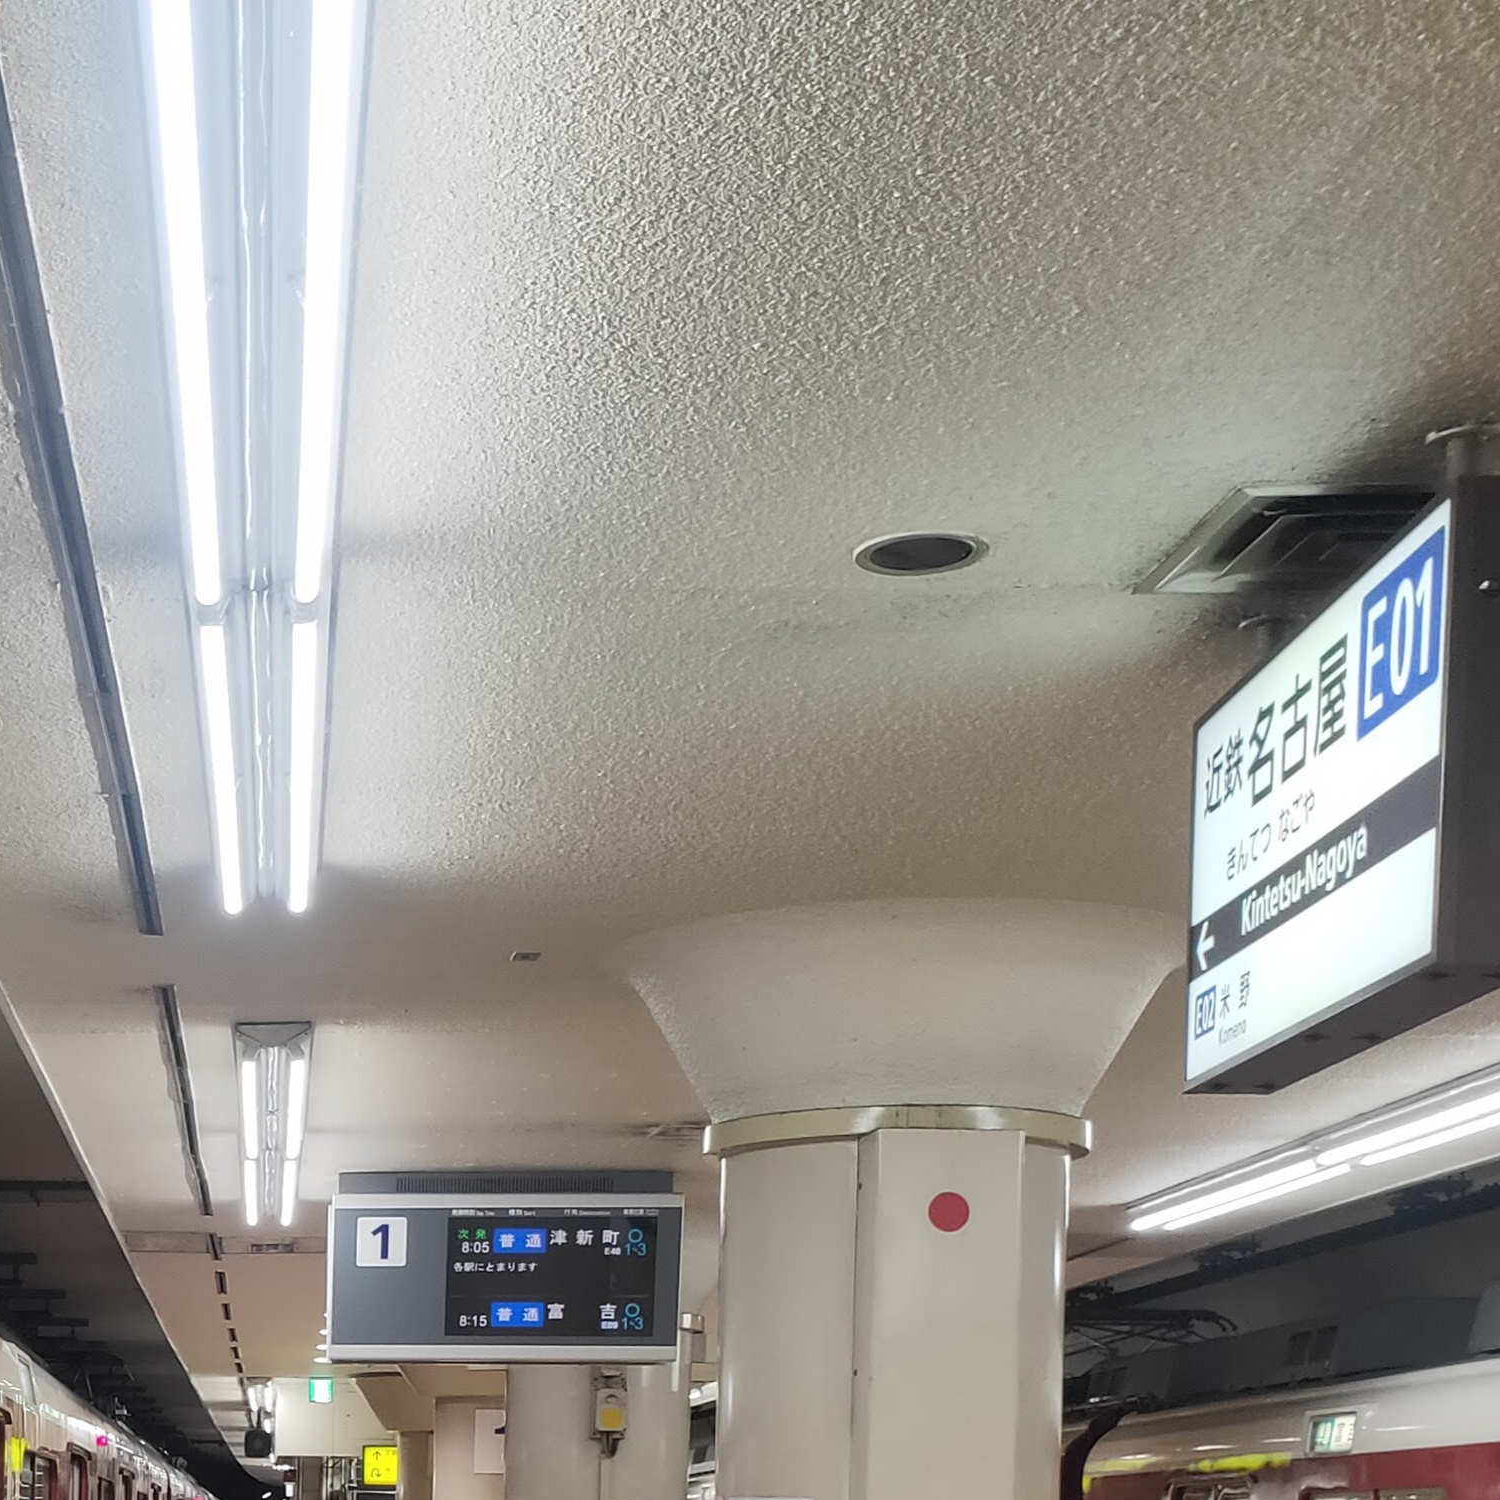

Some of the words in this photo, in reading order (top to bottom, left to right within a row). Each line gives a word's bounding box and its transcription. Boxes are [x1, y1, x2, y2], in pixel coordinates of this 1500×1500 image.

[1364, 557, 1434, 720] E01
[1204, 633, 1348, 819] 近鉄名古屋
[1226, 823, 1271, 881] きんてつ
[1278, 788, 1315, 843] なごや
[1241, 821, 1368, 936] Kintetsu-Nagoya
[370, 1224, 390, 1260] 1
[461, 1241, 490, 1254] 8:05
[499, 1233, 542, 1248] 普通
[550, 1229, 620, 1245] 津新町
[453, 1262, 538, 1273] 各駅にとまります
[459, 1315, 487, 1328] 8:15
[496, 1307, 539, 1322] 普通
